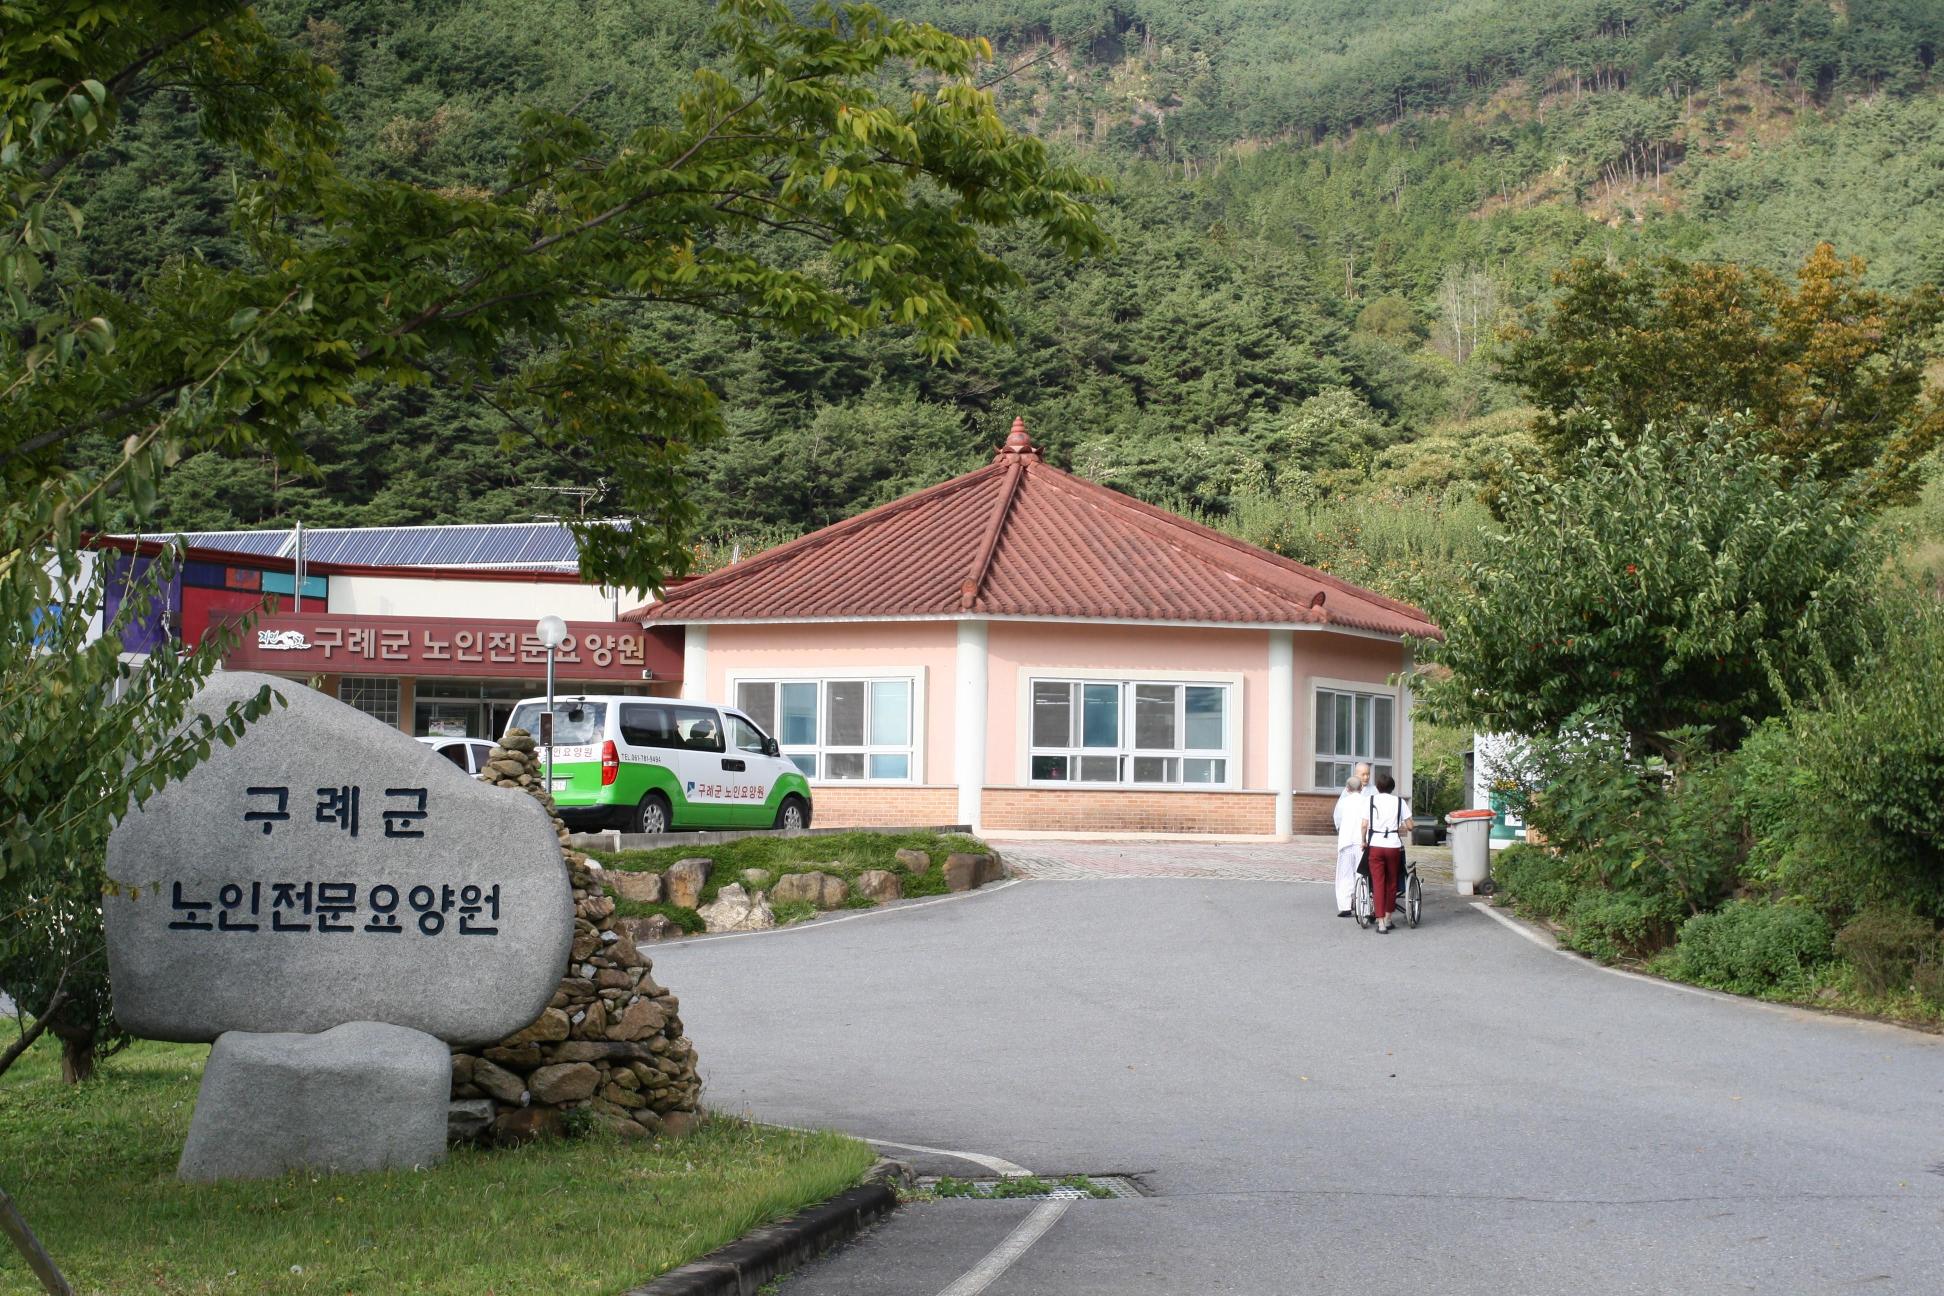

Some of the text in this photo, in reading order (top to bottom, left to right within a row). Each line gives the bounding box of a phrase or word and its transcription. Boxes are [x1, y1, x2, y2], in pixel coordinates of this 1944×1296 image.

[314, 627, 645, 667] 구례군 노인전문요양원
[244, 785, 428, 838] 구례군
[698, 784, 765, 799] 구례군 노인요양원
[168, 881, 500, 936] 노인전문요양원
